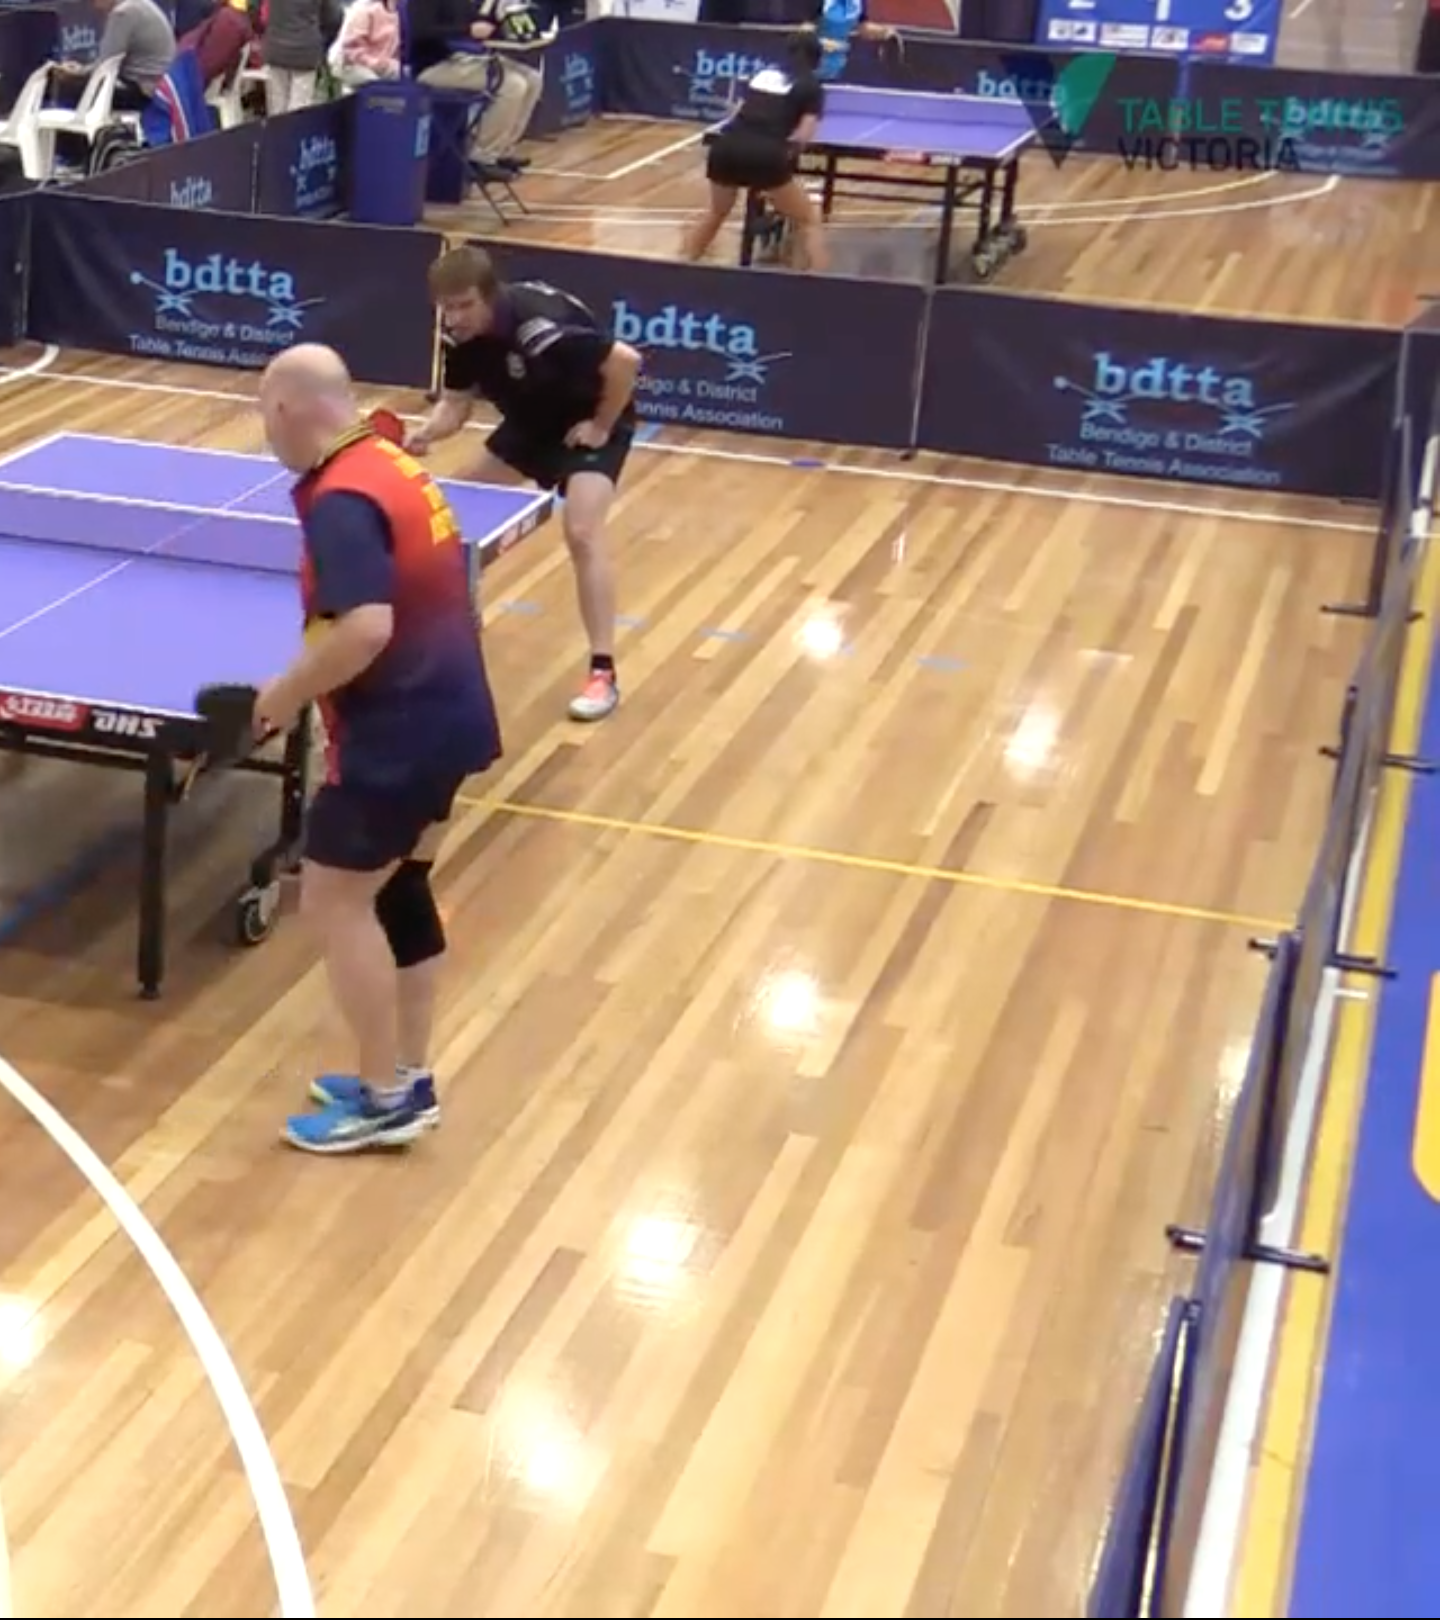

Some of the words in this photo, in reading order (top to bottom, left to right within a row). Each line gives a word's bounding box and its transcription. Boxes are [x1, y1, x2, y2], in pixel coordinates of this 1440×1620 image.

[164, 248, 296, 300] bdtta
[240, 324, 294, 345] District
[613, 300, 758, 356] bdtta
[633, 374, 674, 395] digo
[678, 379, 691, 395] &
[696, 380, 758, 404] District
[1094, 352, 1255, 408] bdtta
[682, 403, 784, 430] Association
[1079, 421, 1160, 449] Bendigo
[1164, 431, 1180, 449] &
[1184, 433, 1253, 457] District
[1047, 443, 1099, 466] Table
[1103, 450, 1164, 474] Tennis
[1168, 458, 1282, 485] Association
